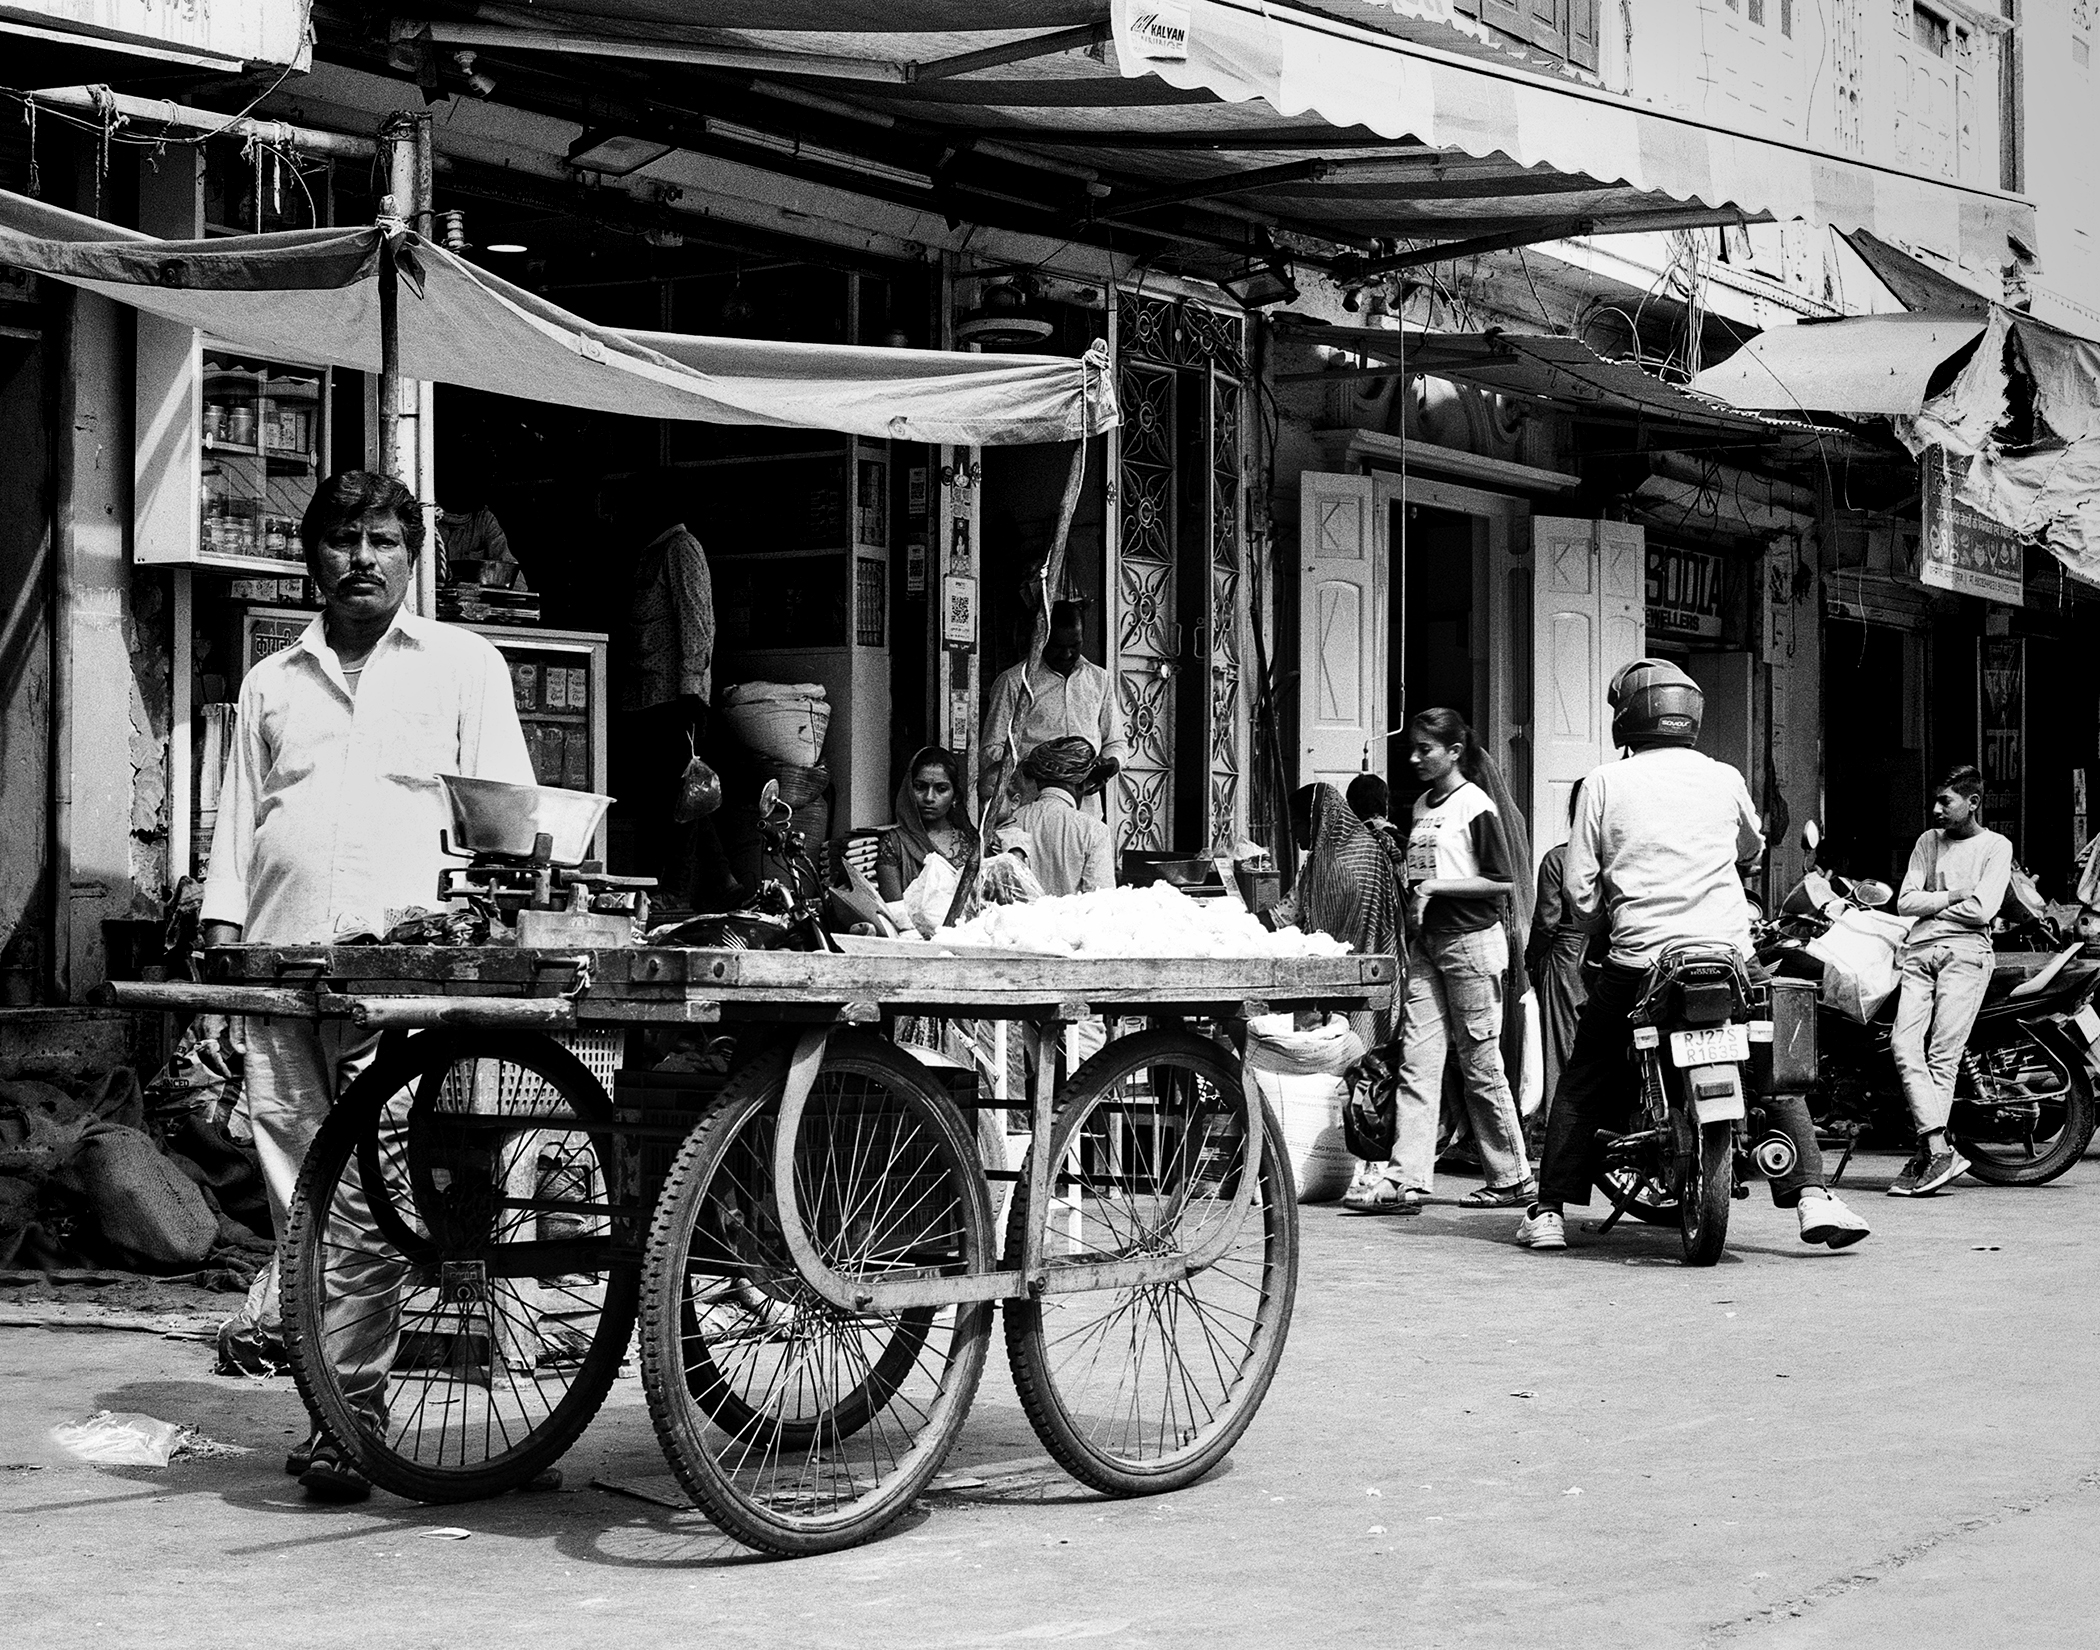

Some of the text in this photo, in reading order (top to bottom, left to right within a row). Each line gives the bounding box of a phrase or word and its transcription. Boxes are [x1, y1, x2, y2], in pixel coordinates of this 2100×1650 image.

[1151, 24, 1185, 42] KALYAN
[1684, 1028, 1737, 1047] RJ27S
[1687, 1044, 1739, 1064] R1635
